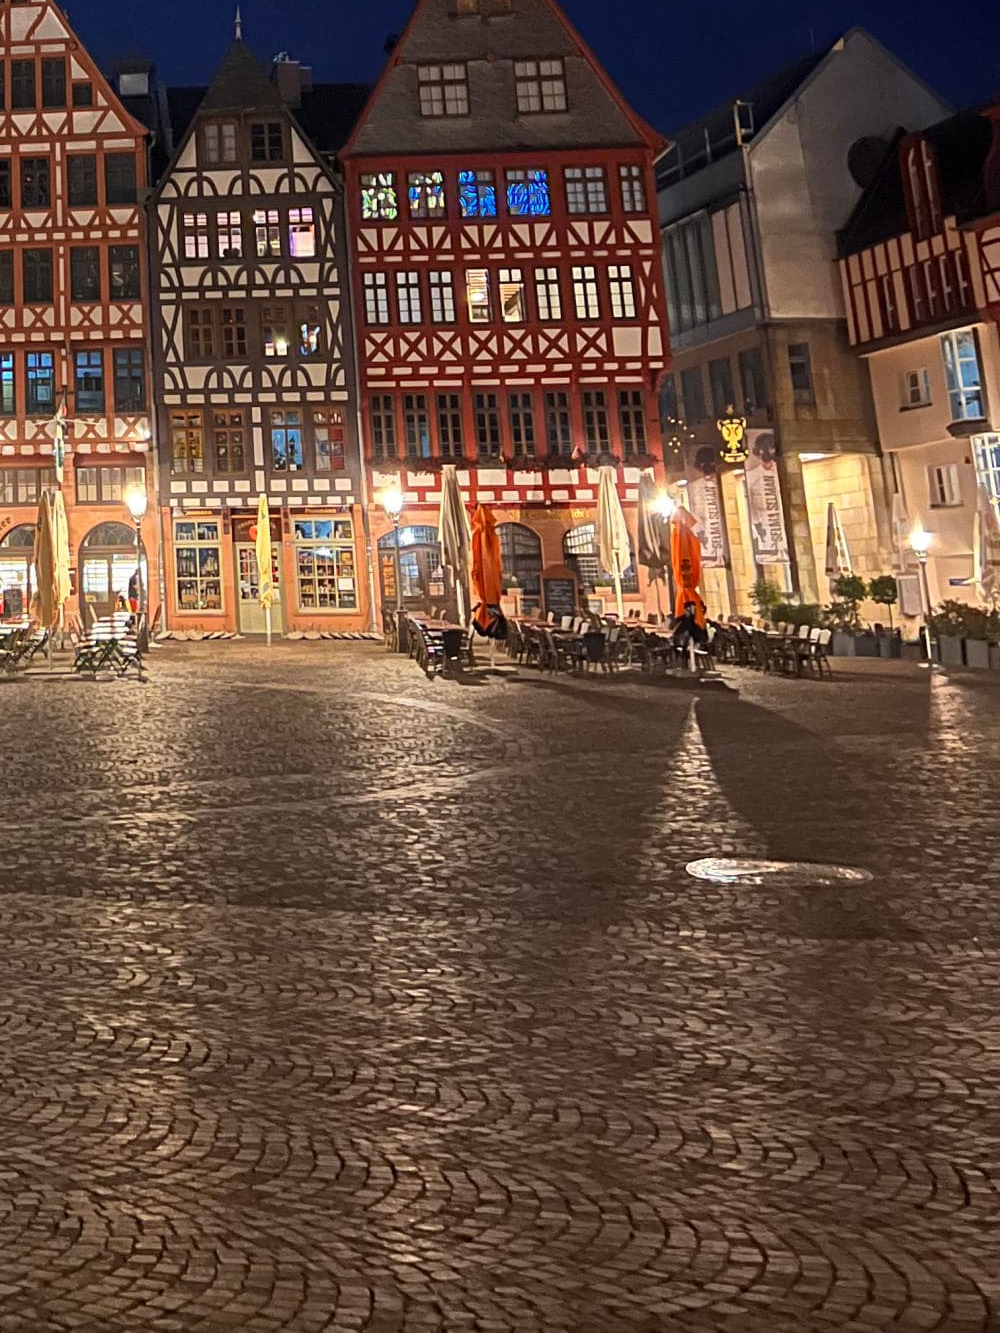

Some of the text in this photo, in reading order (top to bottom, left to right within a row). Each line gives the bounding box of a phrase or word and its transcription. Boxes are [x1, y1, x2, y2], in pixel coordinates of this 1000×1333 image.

[763, 475, 783, 542] SELMA SELMAN
[710, 522, 723, 549] SELMA
